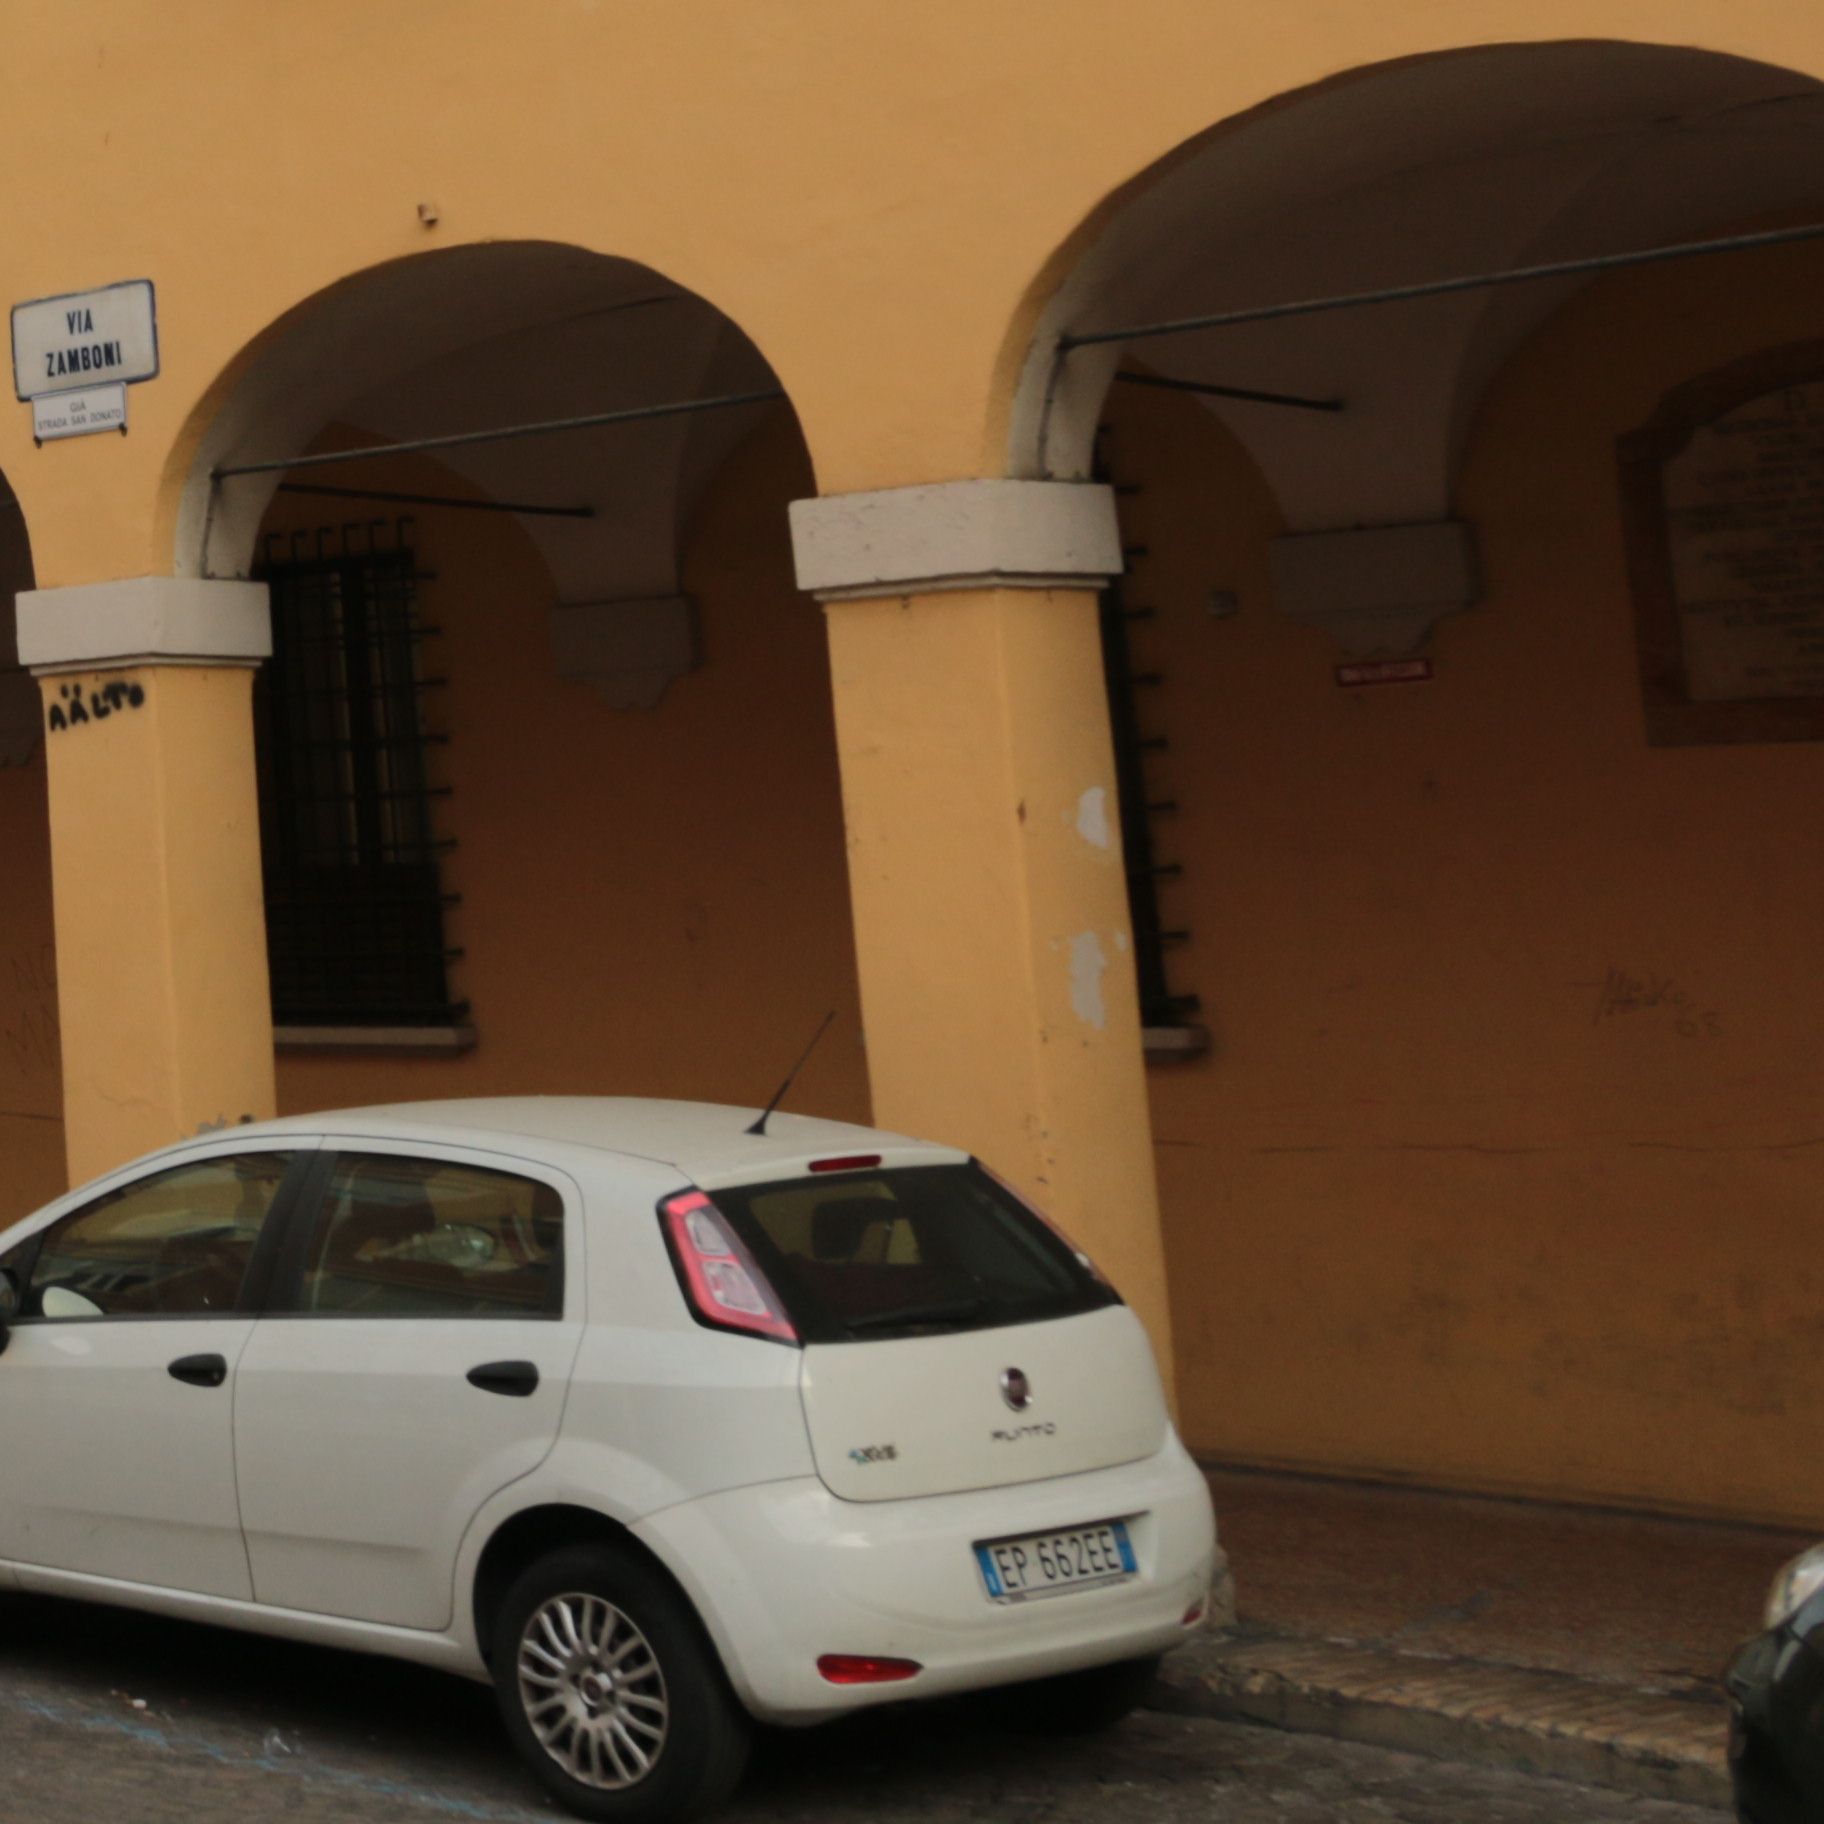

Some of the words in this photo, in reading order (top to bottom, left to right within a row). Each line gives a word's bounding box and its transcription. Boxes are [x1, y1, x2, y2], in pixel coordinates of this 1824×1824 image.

[66, 308, 94, 336] VIA
[45, 341, 122, 378] ZAMBONI
[38, 416, 68, 432] STRADA
[71, 414, 87, 426] SAN
[90, 409, 122, 424] DONATO
[990, 1421, 1057, 1443] PUNTO
[994, 1546, 1027, 1589] EP
[1037, 1530, 1120, 1580] 662EE
